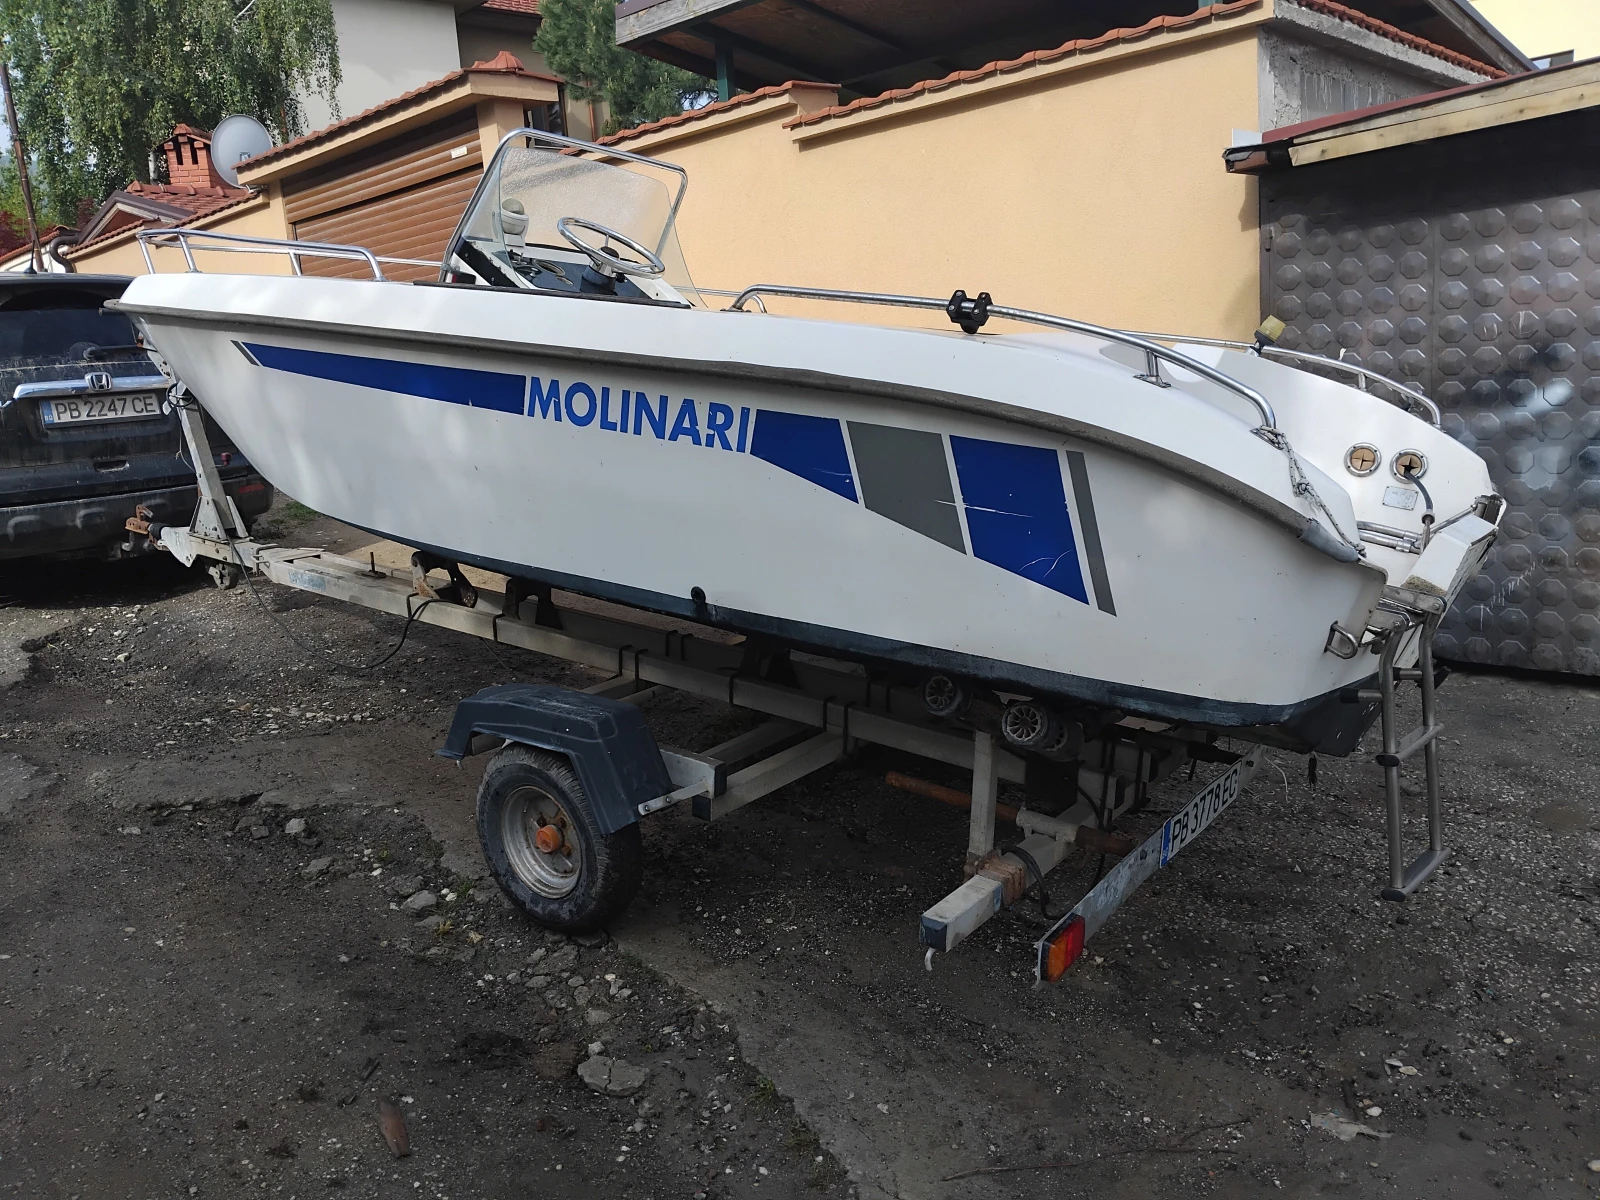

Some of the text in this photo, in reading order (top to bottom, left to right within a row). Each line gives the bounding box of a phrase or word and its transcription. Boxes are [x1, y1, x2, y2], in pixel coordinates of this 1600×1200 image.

[55, 395, 156, 421] PB 2247 CE
[527, 376, 750, 454] MOLINARI
[1171, 768, 1238, 853] PB 3778 EC
